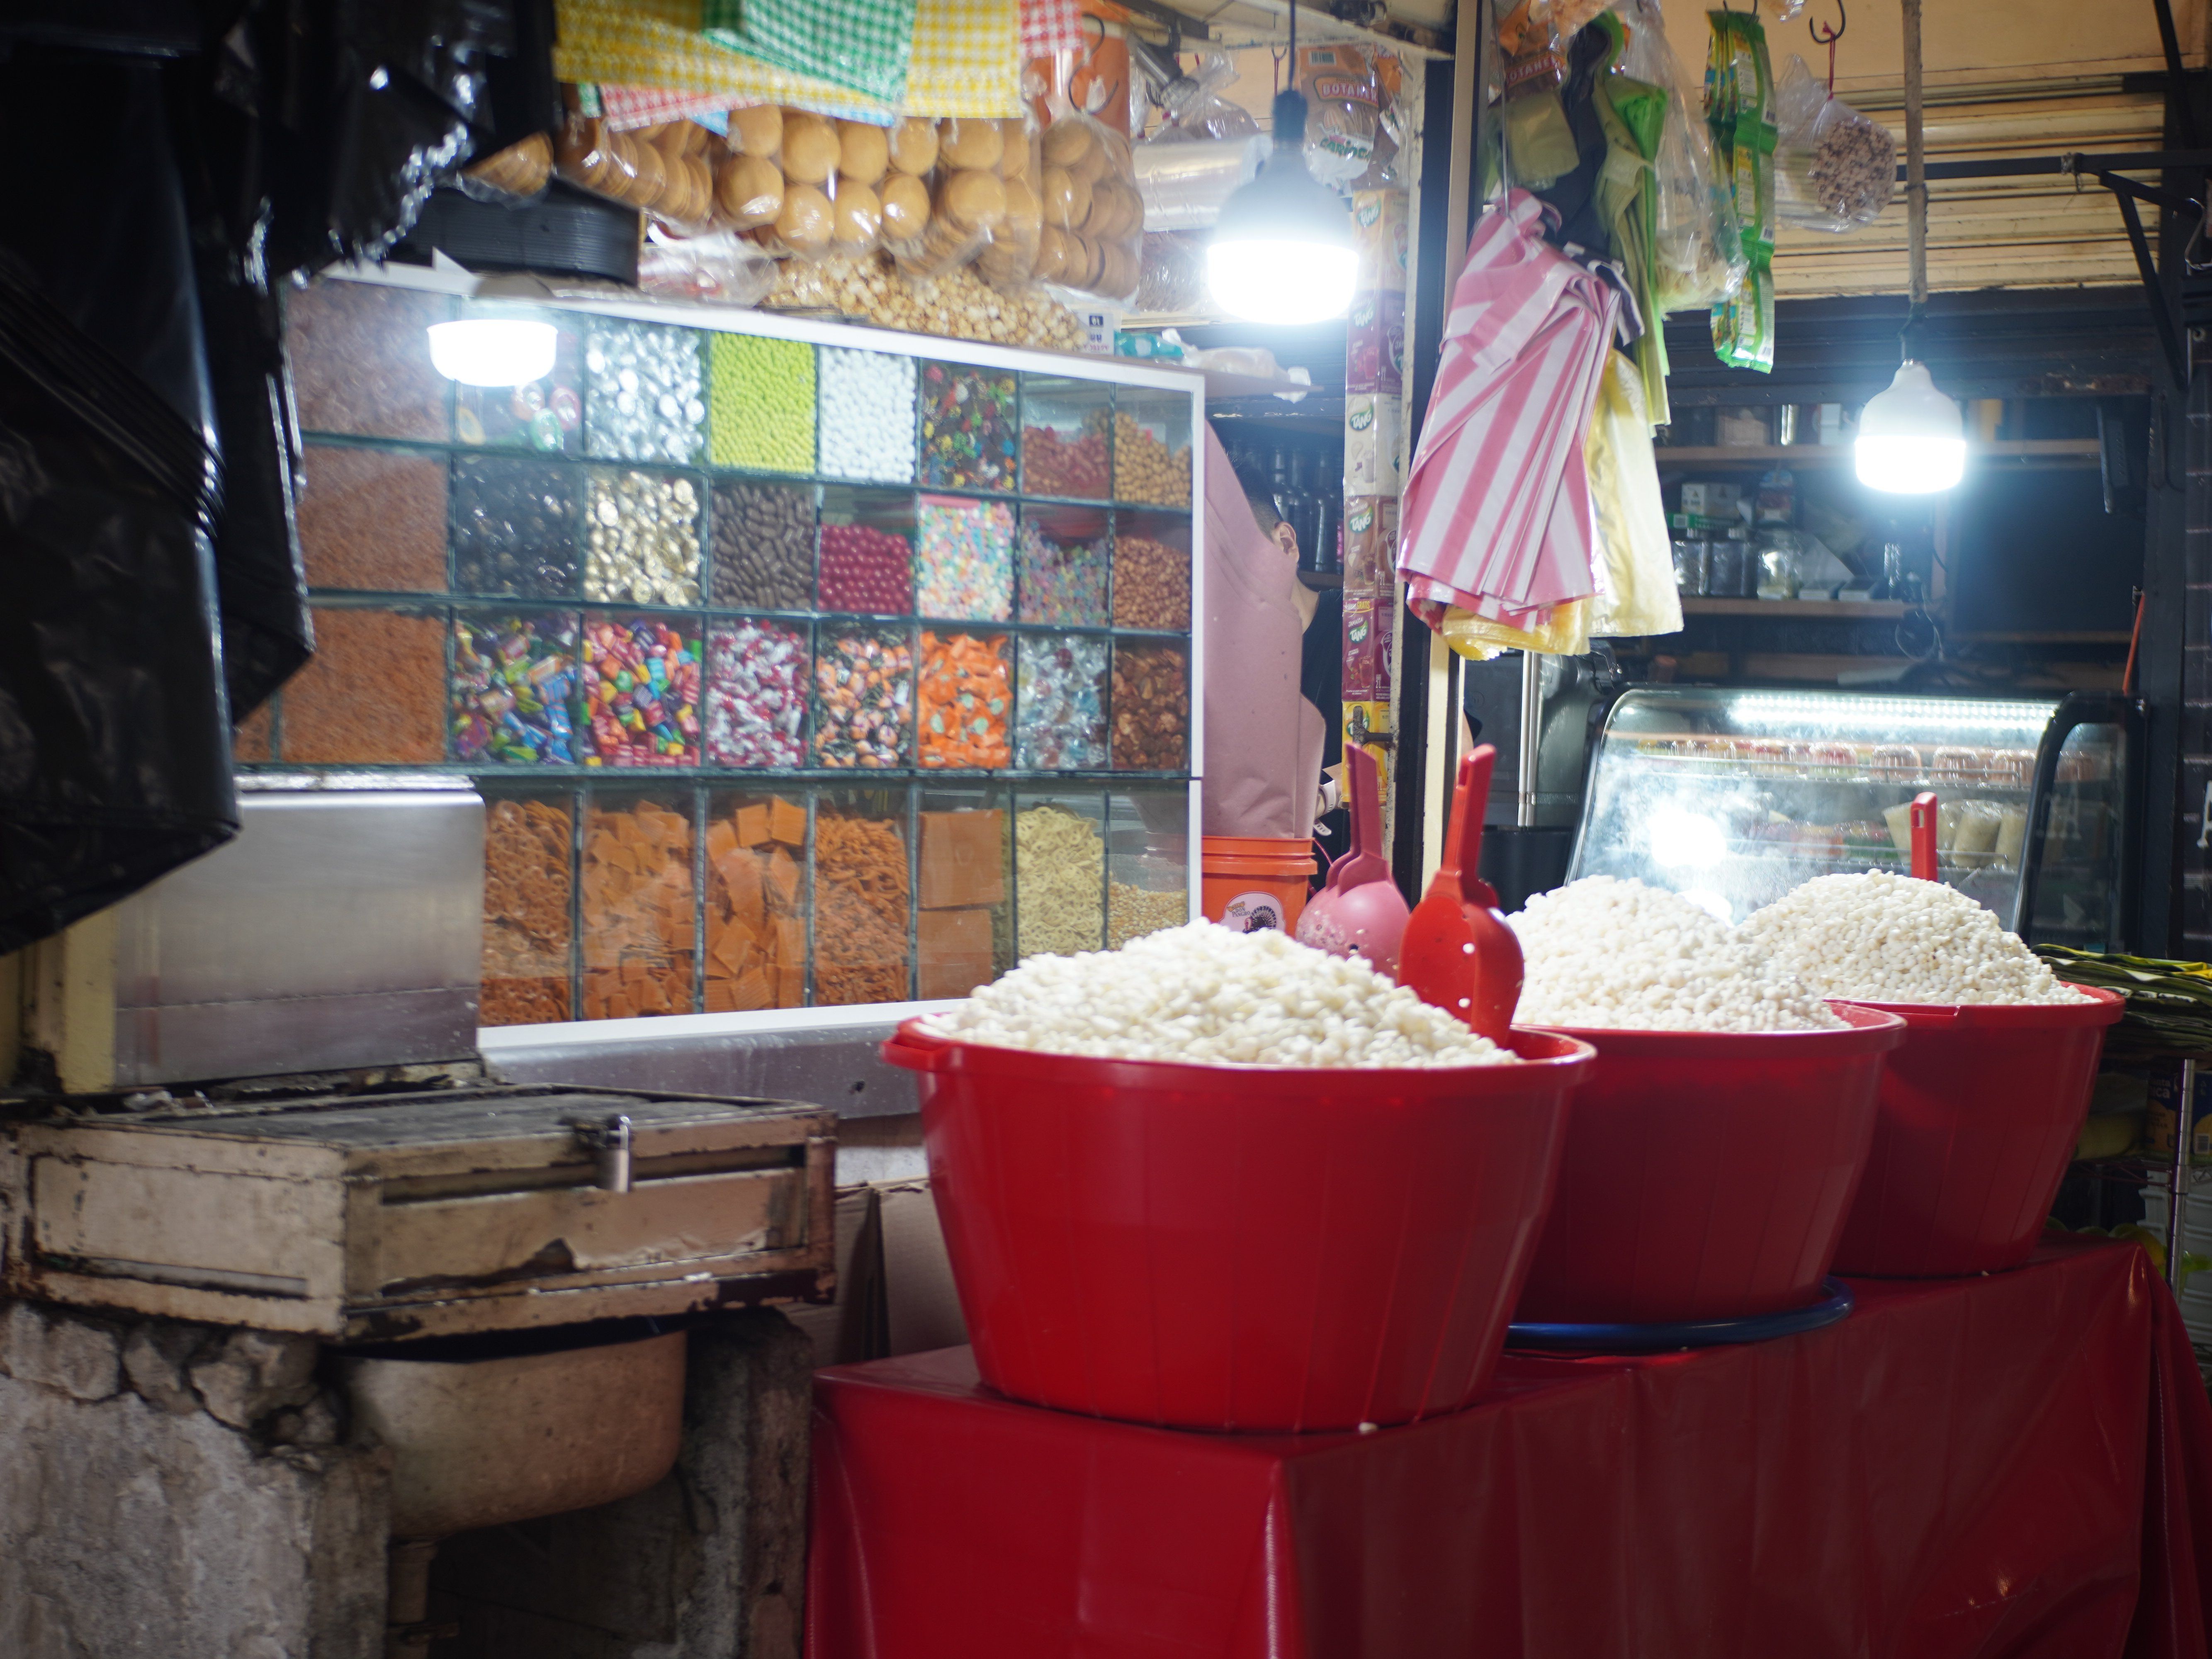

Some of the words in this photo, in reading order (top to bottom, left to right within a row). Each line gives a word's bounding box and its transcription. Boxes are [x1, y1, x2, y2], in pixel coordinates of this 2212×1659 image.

[1354, 309, 1373, 327] TANG
[1351, 410, 1372, 429] TANG
[1350, 513, 1371, 532] TANG
[1348, 617, 1364, 628] JAMAICA
[1349, 626, 1366, 642] TANG
